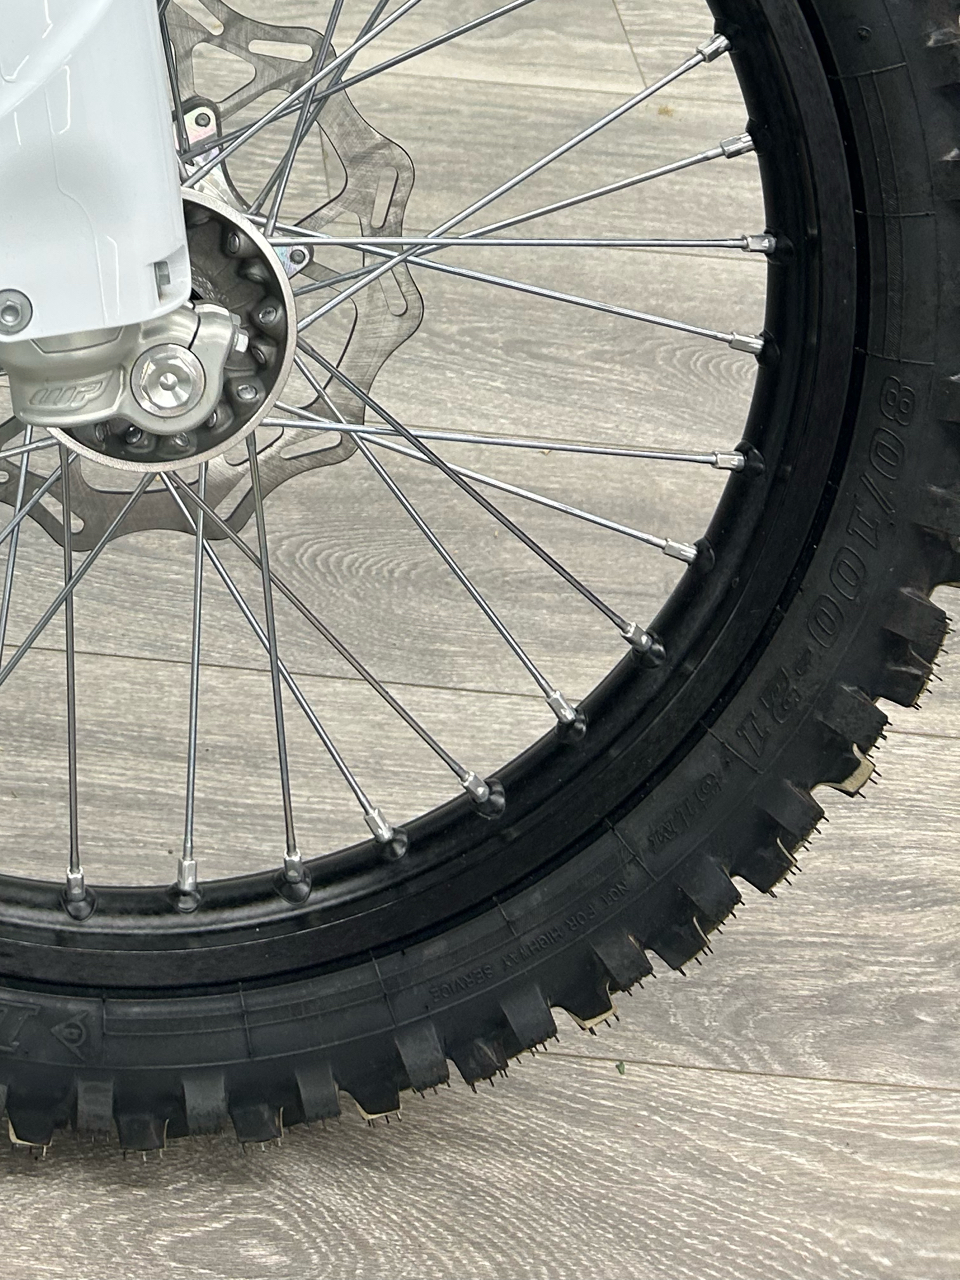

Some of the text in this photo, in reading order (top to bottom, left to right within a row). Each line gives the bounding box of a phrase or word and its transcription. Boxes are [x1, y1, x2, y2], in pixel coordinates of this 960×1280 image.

[735, 375, 917, 758] 80/100-21
[564, 904, 599, 932] FOR
[501, 927, 567, 968] HIGHWAY
[428, 963, 494, 1004] SERVICE
